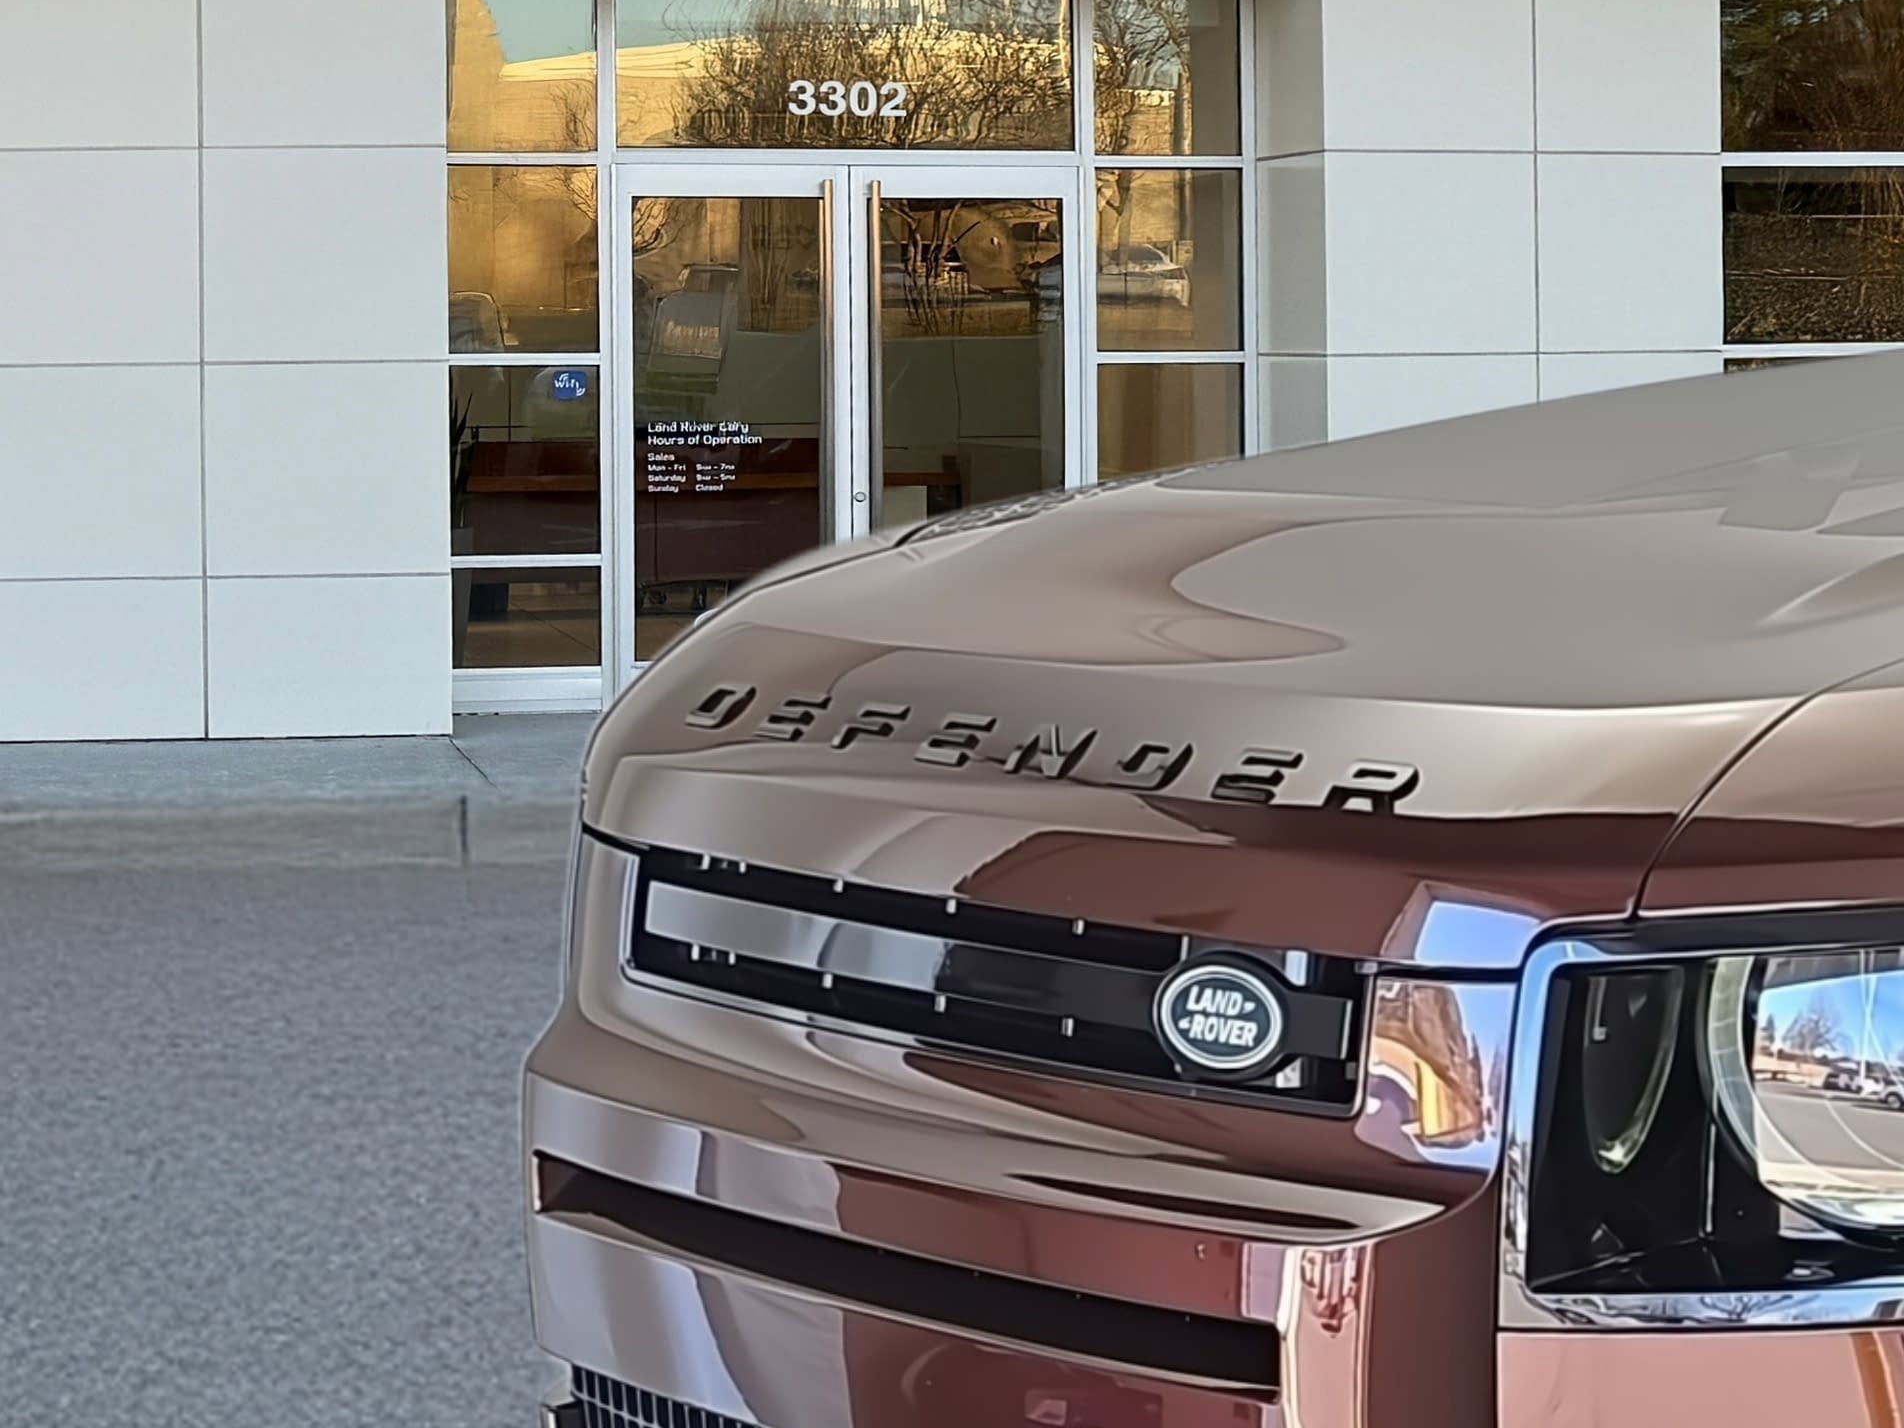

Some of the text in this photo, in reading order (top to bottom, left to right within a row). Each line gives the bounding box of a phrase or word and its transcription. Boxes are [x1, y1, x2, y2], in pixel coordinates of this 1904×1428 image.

[787, 79, 907, 118] 3302
[647, 421, 677, 433] Land
[647, 434, 763, 446] Hours of Operation
[684, 684, 1421, 815] DEFENDER
[1186, 984, 1243, 1016] LAND
[1189, 1014, 1258, 1047] ROVER
